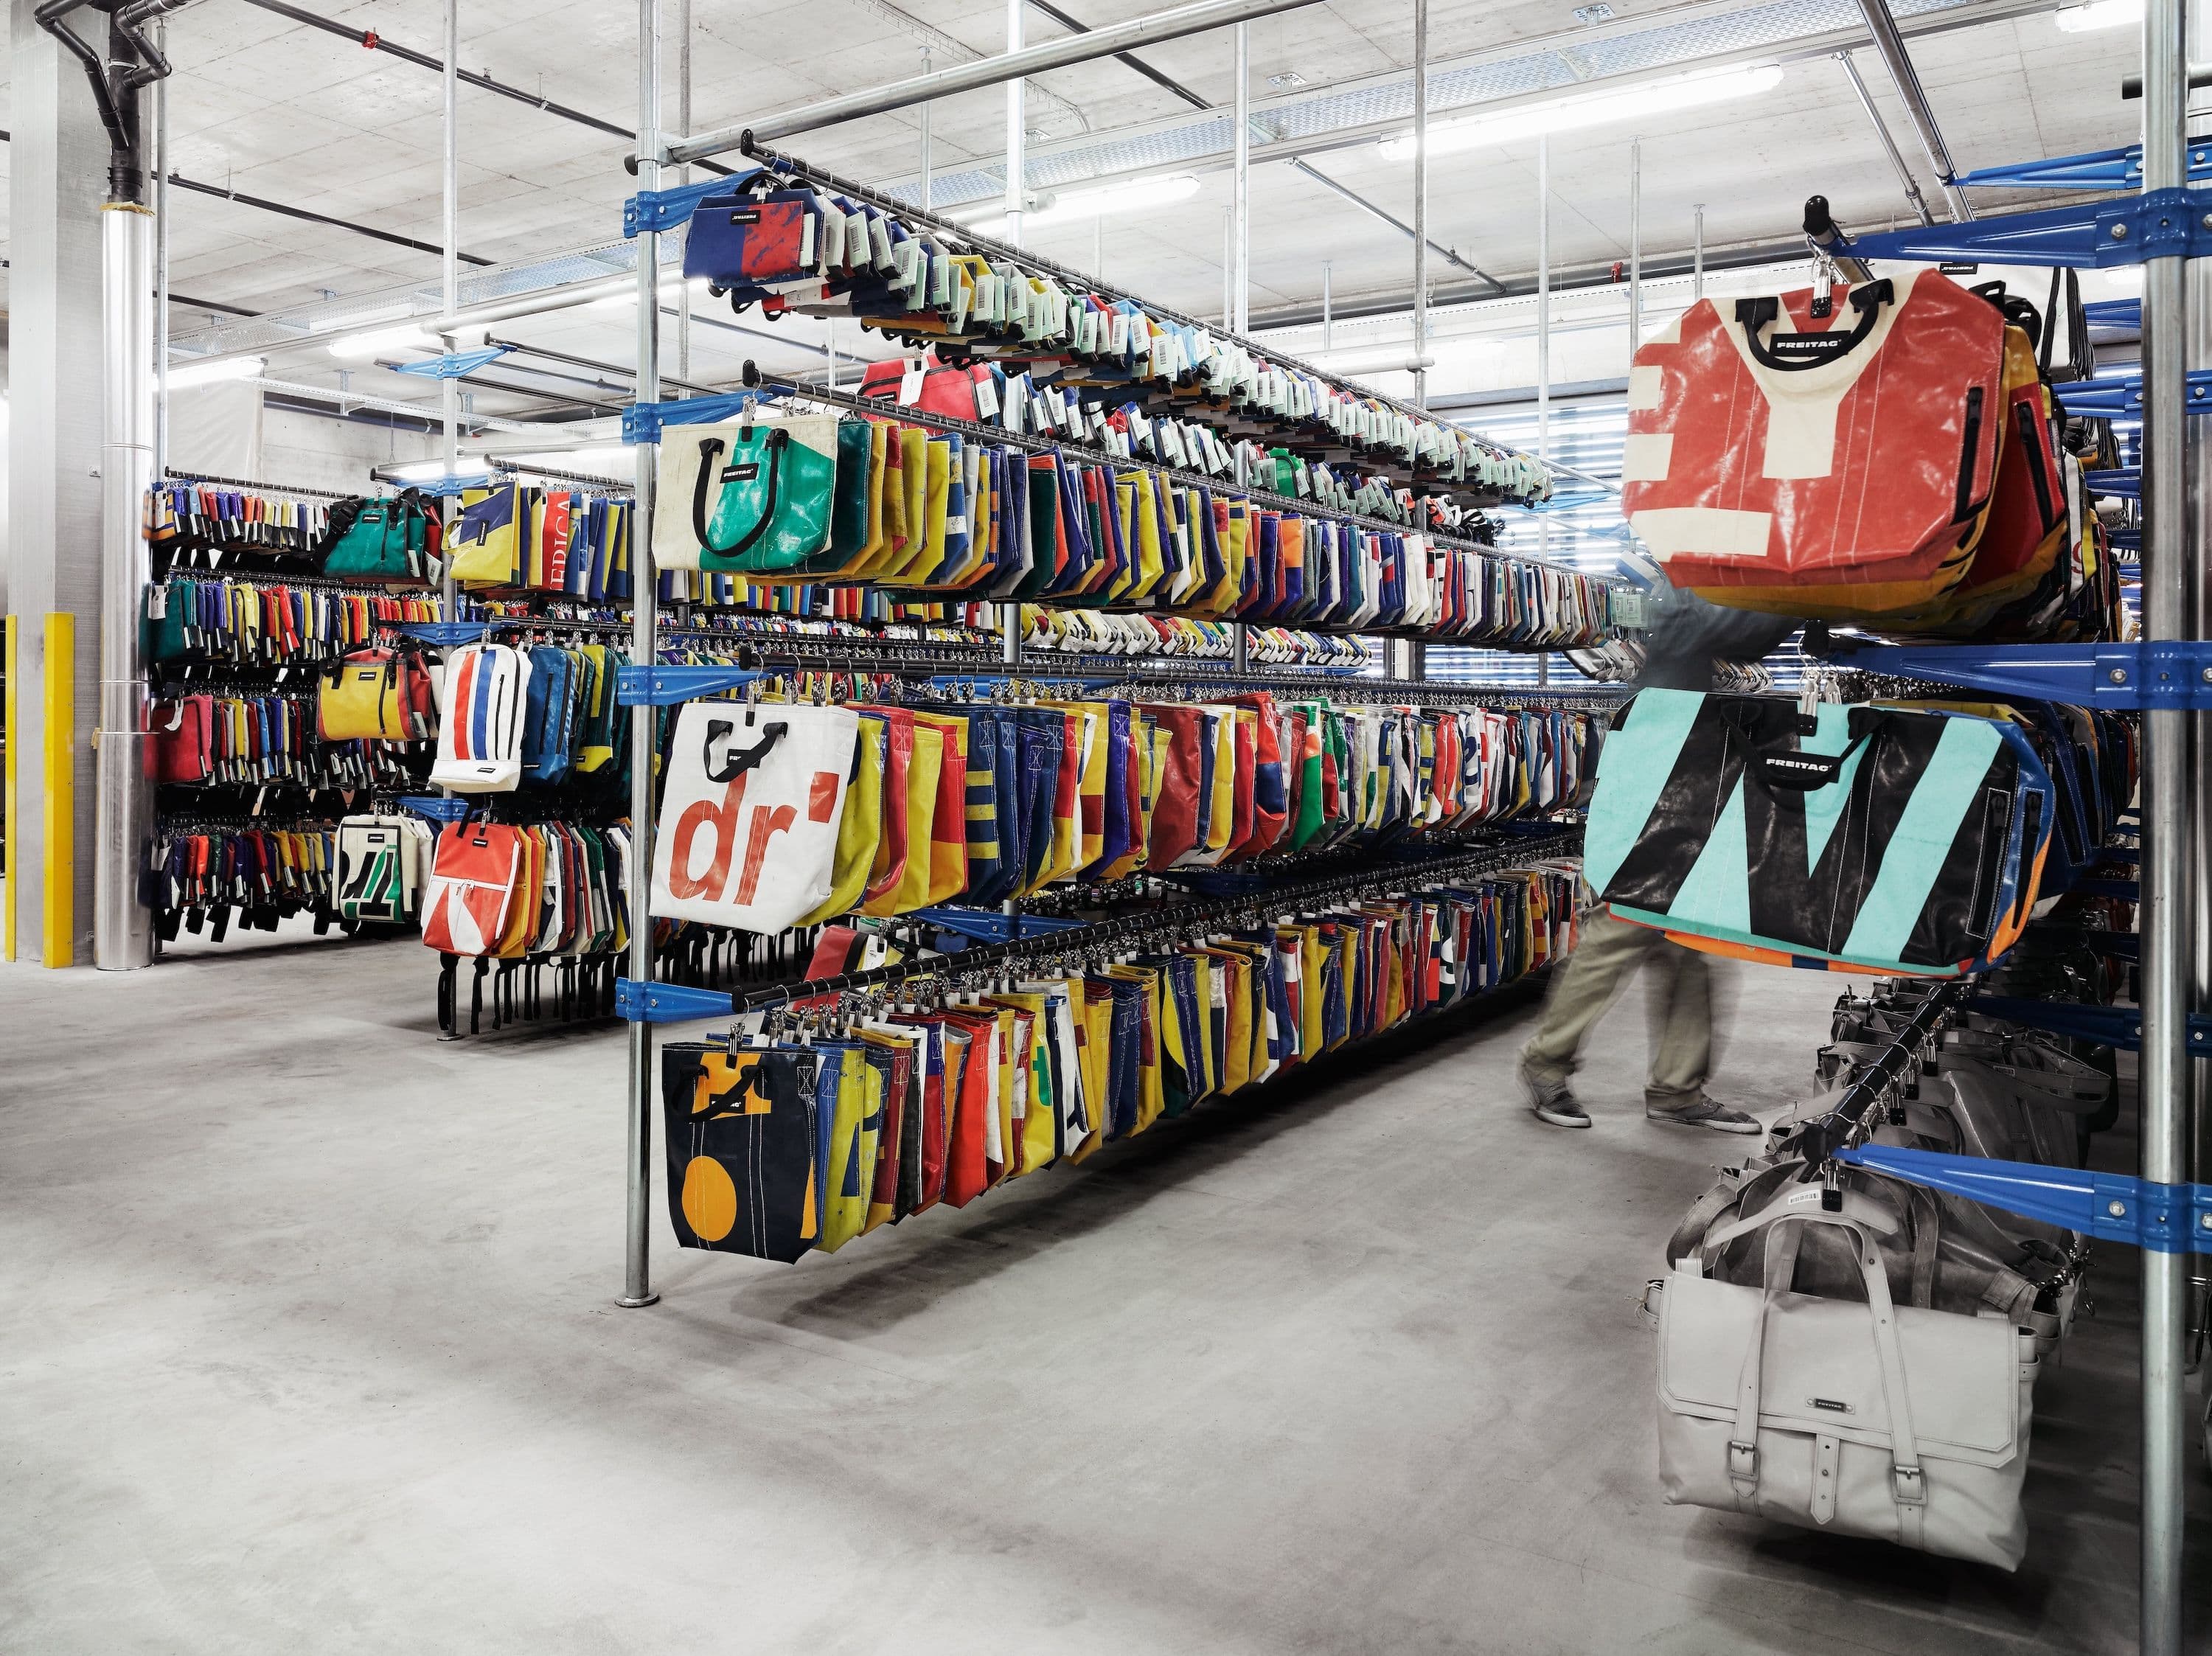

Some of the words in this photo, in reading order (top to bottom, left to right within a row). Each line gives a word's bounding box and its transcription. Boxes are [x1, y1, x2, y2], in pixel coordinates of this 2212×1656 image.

[1777, 340, 1839, 349] FREITAG
[723, 469, 752, 478] FREITAG
[1766, 759, 1830, 772] FREITAG
